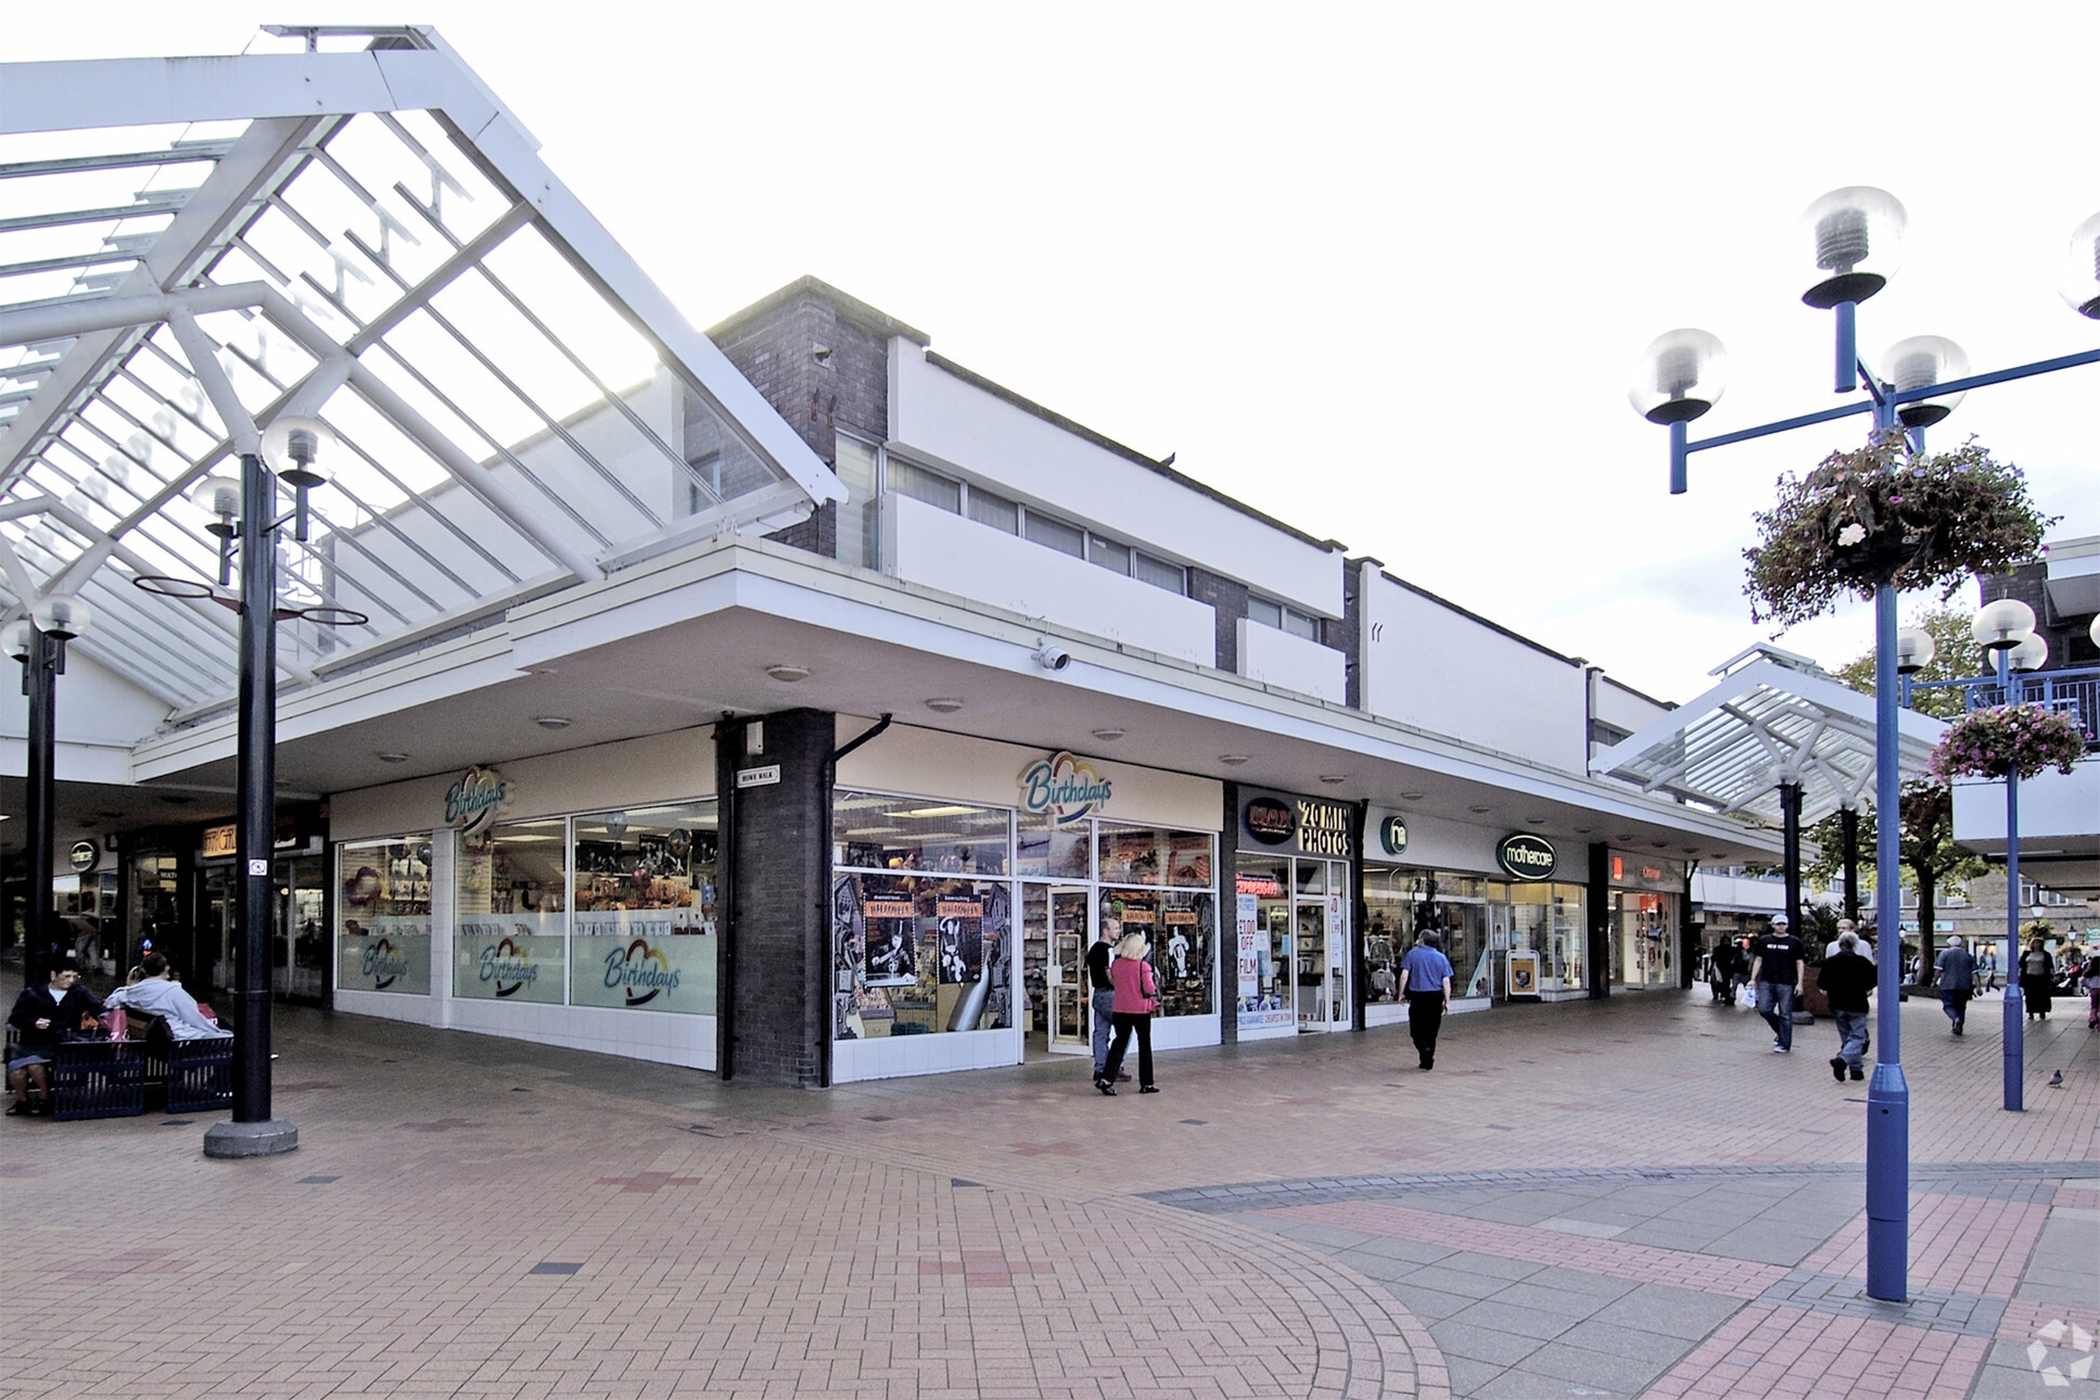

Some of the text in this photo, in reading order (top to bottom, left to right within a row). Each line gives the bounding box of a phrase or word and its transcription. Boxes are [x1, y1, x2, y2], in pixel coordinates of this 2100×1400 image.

[445, 782, 506, 822] Birthdays
[1025, 763, 1111, 809] Birthdays
[1298, 828, 1351, 856] PHOTOS
[1507, 845, 1552, 867] mothercare
[1241, 936, 1254, 951] OFF
[363, 944, 408, 982] Birthdays
[479, 946, 538, 985] Birthdays
[604, 947, 682, 997] Birthdays
[1239, 958, 1257, 974] FILM
